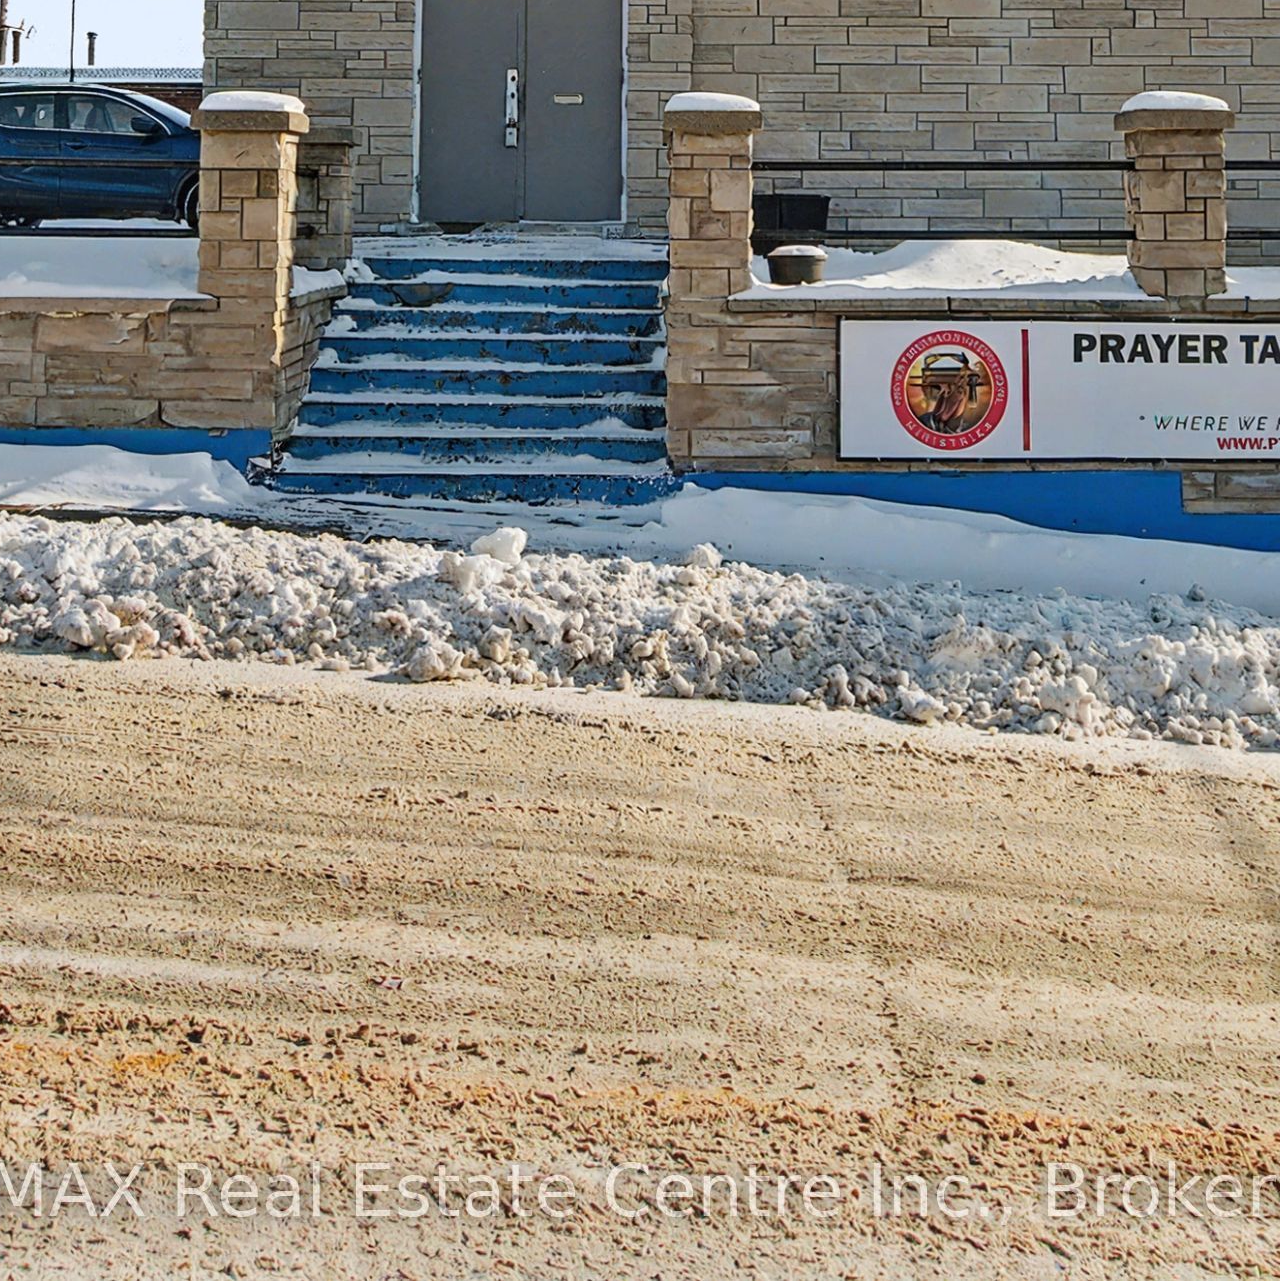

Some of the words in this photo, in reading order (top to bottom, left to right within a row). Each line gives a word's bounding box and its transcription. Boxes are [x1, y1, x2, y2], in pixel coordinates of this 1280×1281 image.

[1073, 333, 1228, 364] PRAYER
[1154, 415, 1229, 432] WHERE
[1238, 416, 1268, 432] WE
